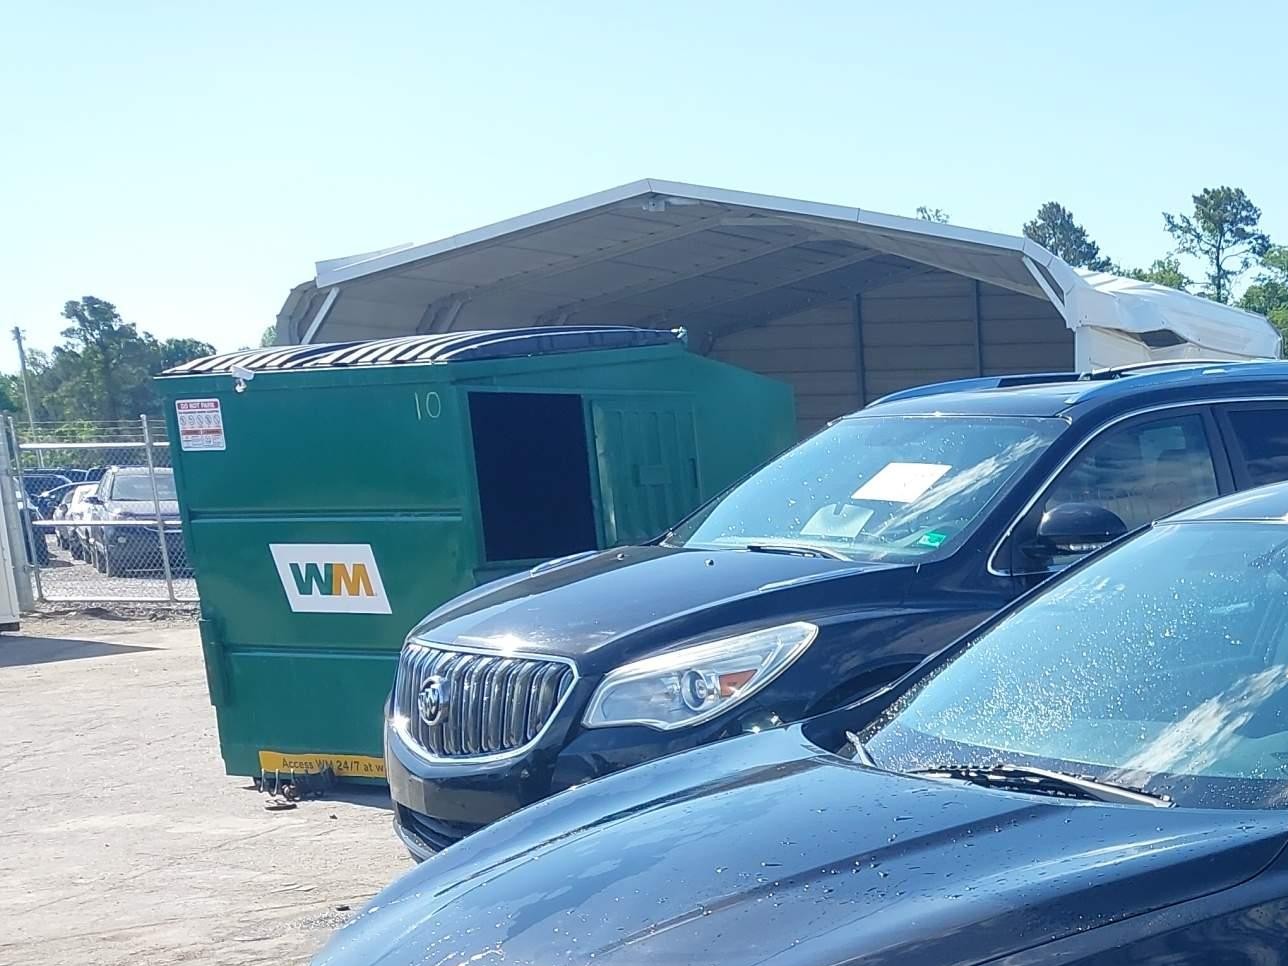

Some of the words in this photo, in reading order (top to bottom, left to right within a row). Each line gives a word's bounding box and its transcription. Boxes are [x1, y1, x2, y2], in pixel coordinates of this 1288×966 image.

[415, 391, 441, 420] 10
[288, 562, 376, 596] WM
[282, 759, 313, 769] Access
[337, 760, 360, 771] 24/7
[364, 764, 375, 772] at
